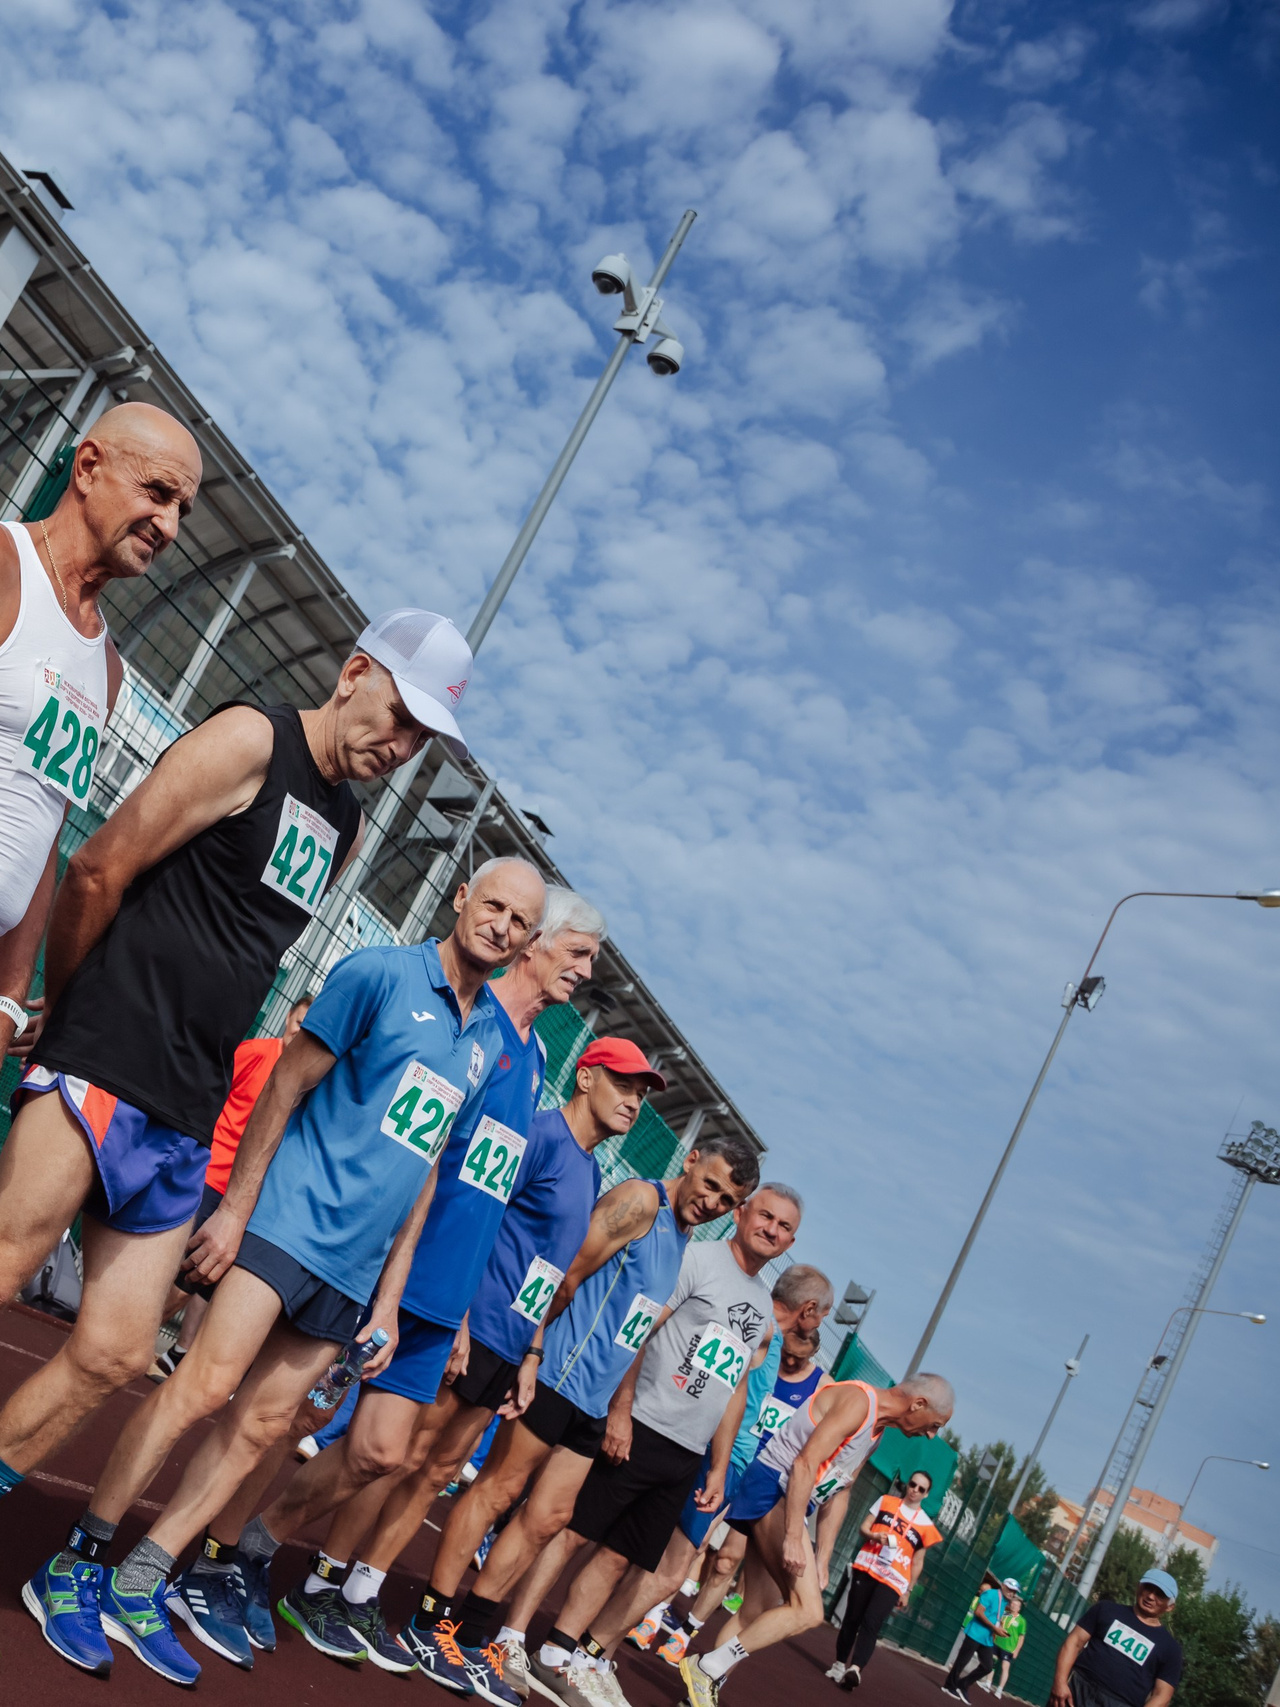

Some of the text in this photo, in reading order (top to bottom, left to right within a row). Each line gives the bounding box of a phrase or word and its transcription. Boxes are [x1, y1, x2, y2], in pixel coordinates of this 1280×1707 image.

[23, 695, 99, 800] 428
[270, 823, 333, 907] 427
[465, 1136, 520, 1198] 424
[519, 1275, 555, 1321] 42
[621, 1310, 654, 1350] 42
[686, 1369, 710, 1399] Ree
[697, 1337, 744, 1388] 423
[1107, 1628, 1149, 1663] 440
